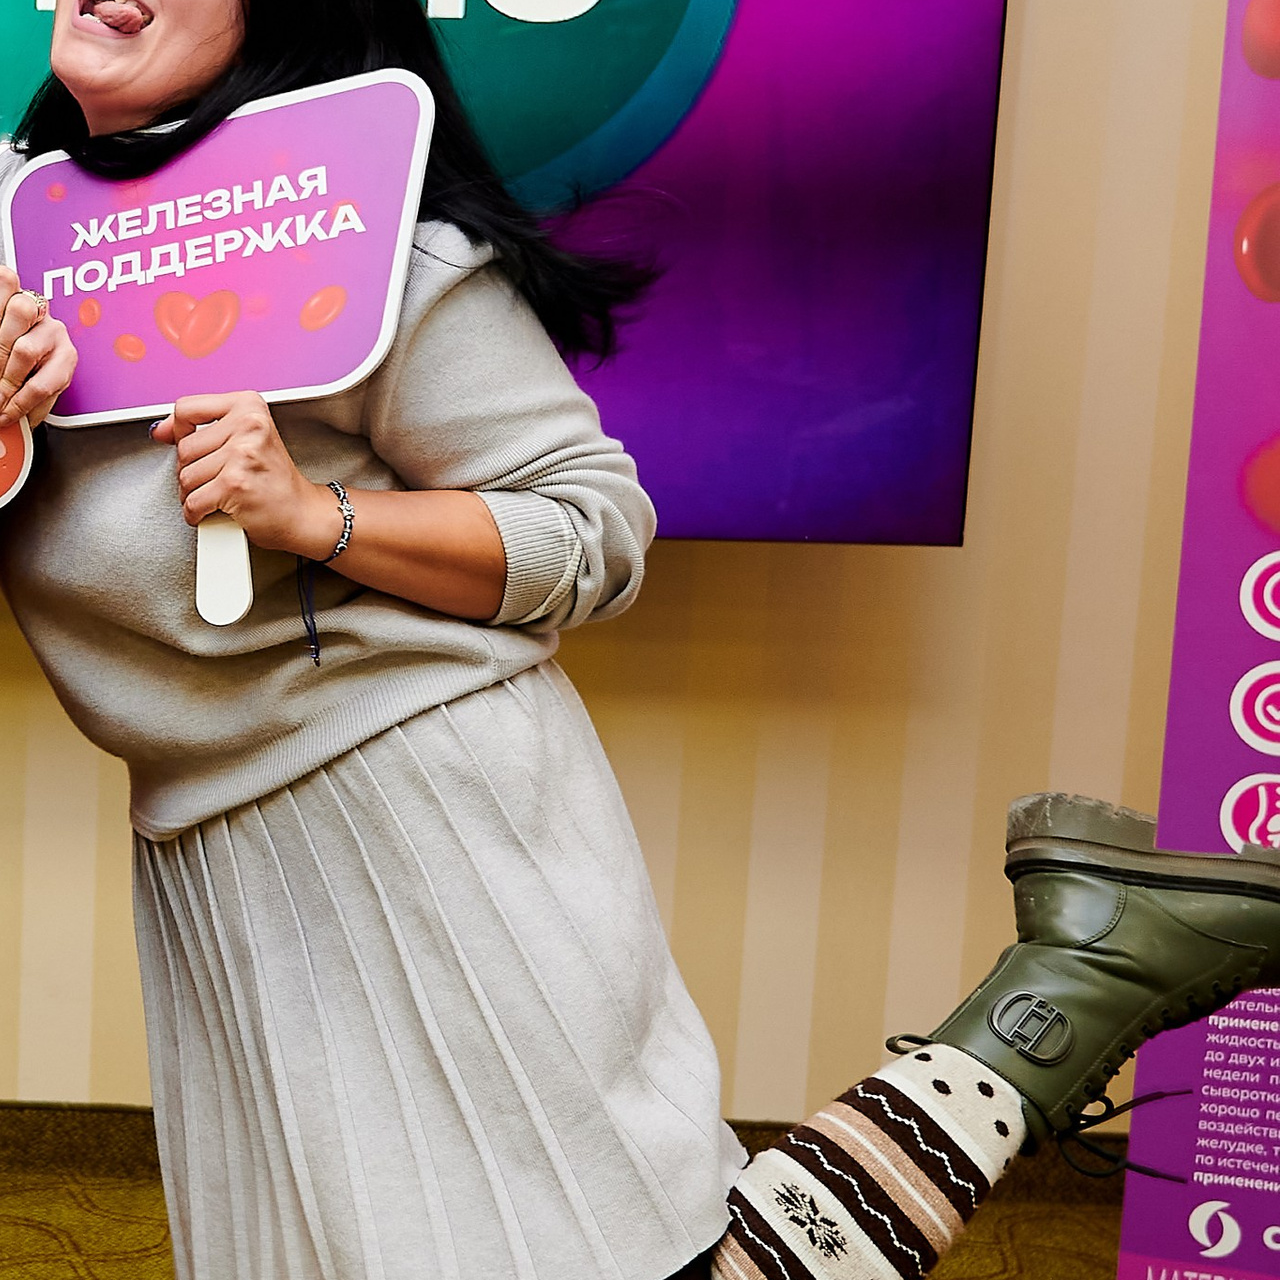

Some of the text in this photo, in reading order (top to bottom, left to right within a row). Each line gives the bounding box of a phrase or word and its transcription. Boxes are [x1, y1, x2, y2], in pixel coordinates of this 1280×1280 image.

[70, 165, 328, 252] ЖЕЛЕЗНАЯ
[42, 204, 367, 300] ПОДДЕРЖКА
[1204, 1050, 1225, 1062] до
[1228, 1053, 1266, 1067] двух
[1203, 1068, 1260, 1082] недели
[1200, 1103, 1260, 1117] хорошо
[1196, 1138, 1267, 1156] желудке,
[1195, 1154, 1280, 1174] по истечен
